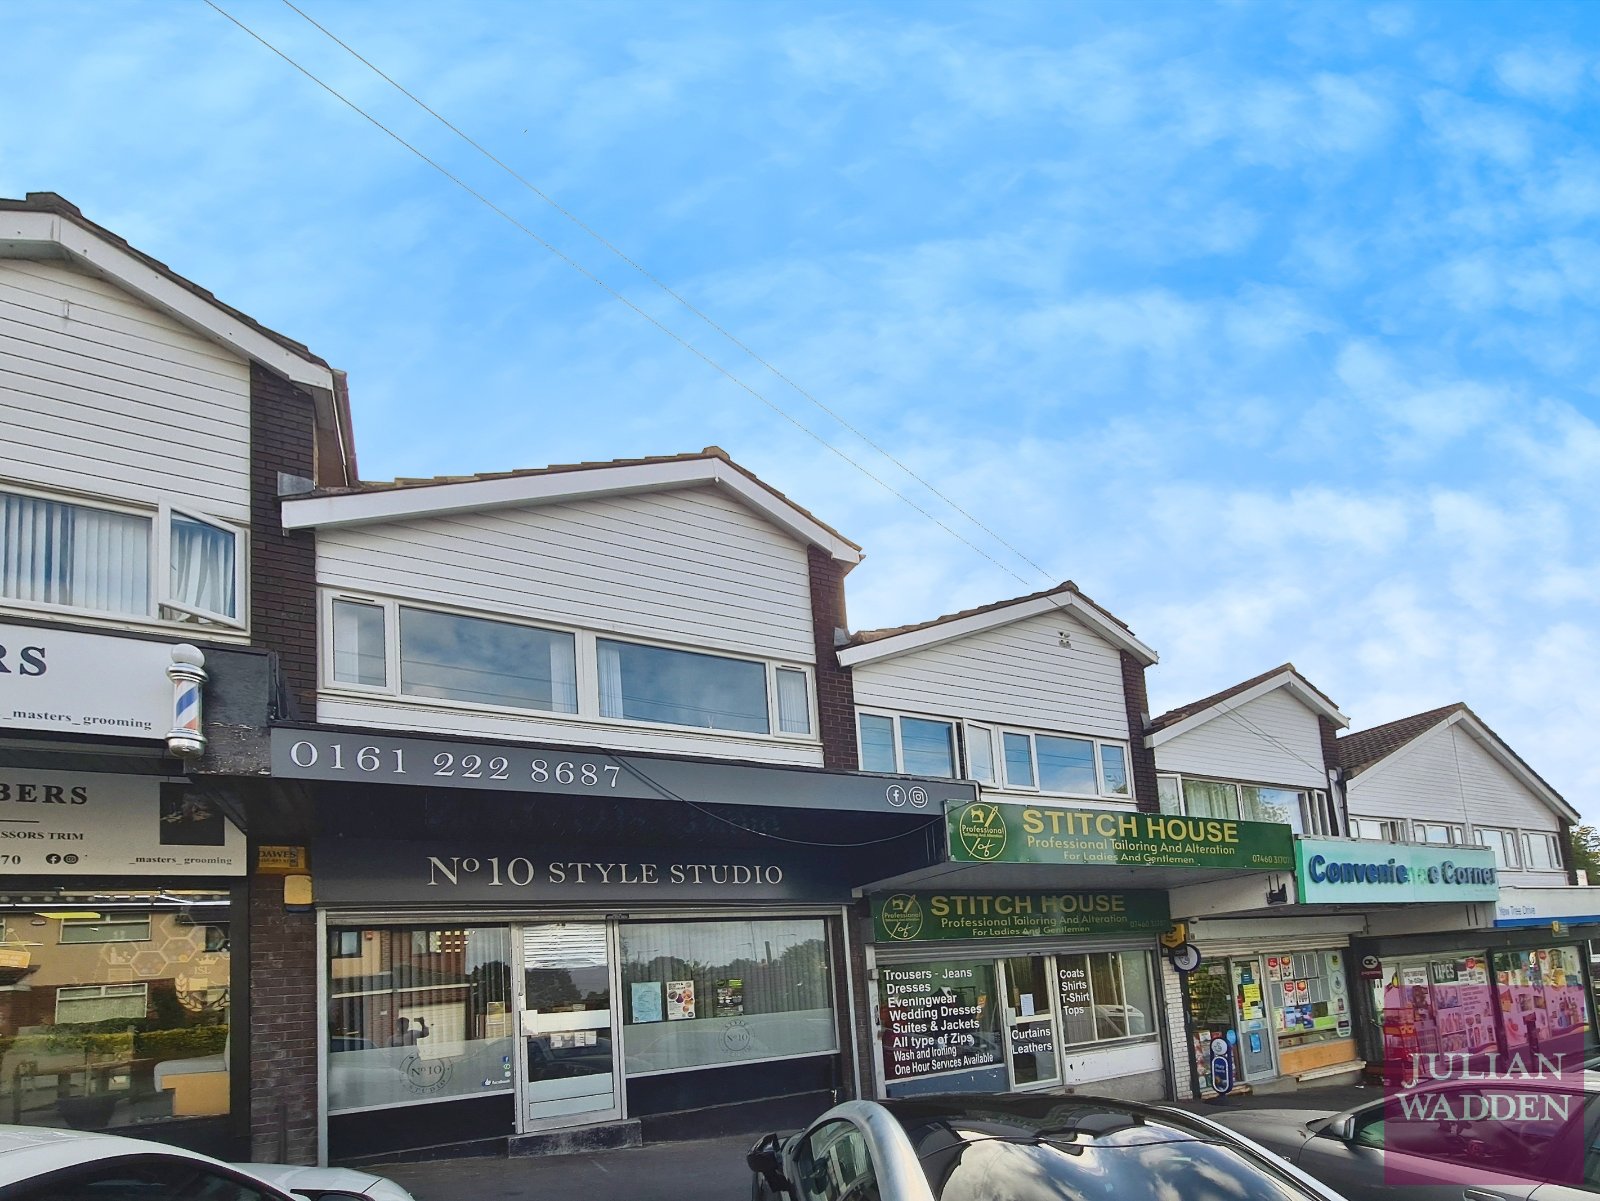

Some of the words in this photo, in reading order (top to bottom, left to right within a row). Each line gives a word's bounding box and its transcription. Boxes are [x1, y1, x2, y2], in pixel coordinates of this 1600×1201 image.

[289, 741, 407, 774] 0161
[432, 752, 510, 780] 222
[530, 759, 621, 788] 8687
[1022, 808, 1138, 838] STITCH
[1146, 817, 1239, 843] HOUSE
[48, 832, 84, 841] TRIM
[1027, 835, 1108, 850] Professional
[1109, 838, 1158, 855] Tailoring
[1159, 842, 1182, 853] And
[1184, 843, 1236, 855] Alteration
[1064, 851, 1081, 860] For
[1083, 851, 1119, 862] Ladies
[1120, 852, 1142, 862] And
[1143, 854, 1195, 865] Gentlemen
[549, 862, 659, 884] STYLE
[670, 863, 784, 885] STUDIO
[1442, 860, 1496, 885] Corner
[930, 895, 1033, 916] STITCH
[1041, 894, 1126, 914] HOUSE
[941, 916, 1011, 928] Professional
[1012, 915, 1057, 926] Tailoring
[1060, 915, 1079, 924] And
[1081, 914, 1128, 923] Alteration
[972, 928, 988, 936] For
[989, 927, 1020, 936] Ladies
[1021, 927, 1040, 935] And
[1043, 926, 1091, 934] Gentlemen
[884, 969, 932, 981] Trousers
[942, 969, 973, 979] Jeans
[1059, 968, 1085, 979] Coats
[887, 983, 931, 995] Dresses
[1061, 980, 1087, 992] Shirts
[888, 994, 957, 1008] Eveningwear
[1061, 992, 1090, 1003] T-Shirt
[889, 1008, 938, 1022] Wedding
[940, 1005, 982, 1017] Dresses
[1063, 1005, 1085, 1017] Tops
[893, 1022, 928, 1034] Suites
[930, 1021, 939, 1031] &
[940, 1019, 980, 1031] Jackets
[1011, 1027, 1051, 1040] Curtains
[893, 1036, 908, 1048] All
[911, 1036, 934, 1049] type
[937, 1033, 948, 1045] of
[950, 1032, 974, 1046] Zips
[893, 1049, 915, 1062] Wash
[916, 1047, 931, 1060] and
[931, 1046, 957, 1057] Ironing
[1012, 1042, 1052, 1055] Leathers
[894, 1064, 911, 1076] One
[912, 1061, 930, 1073] Hour
[931, 1057, 962, 1070] Services
[963, 1052, 994, 1066] Available
